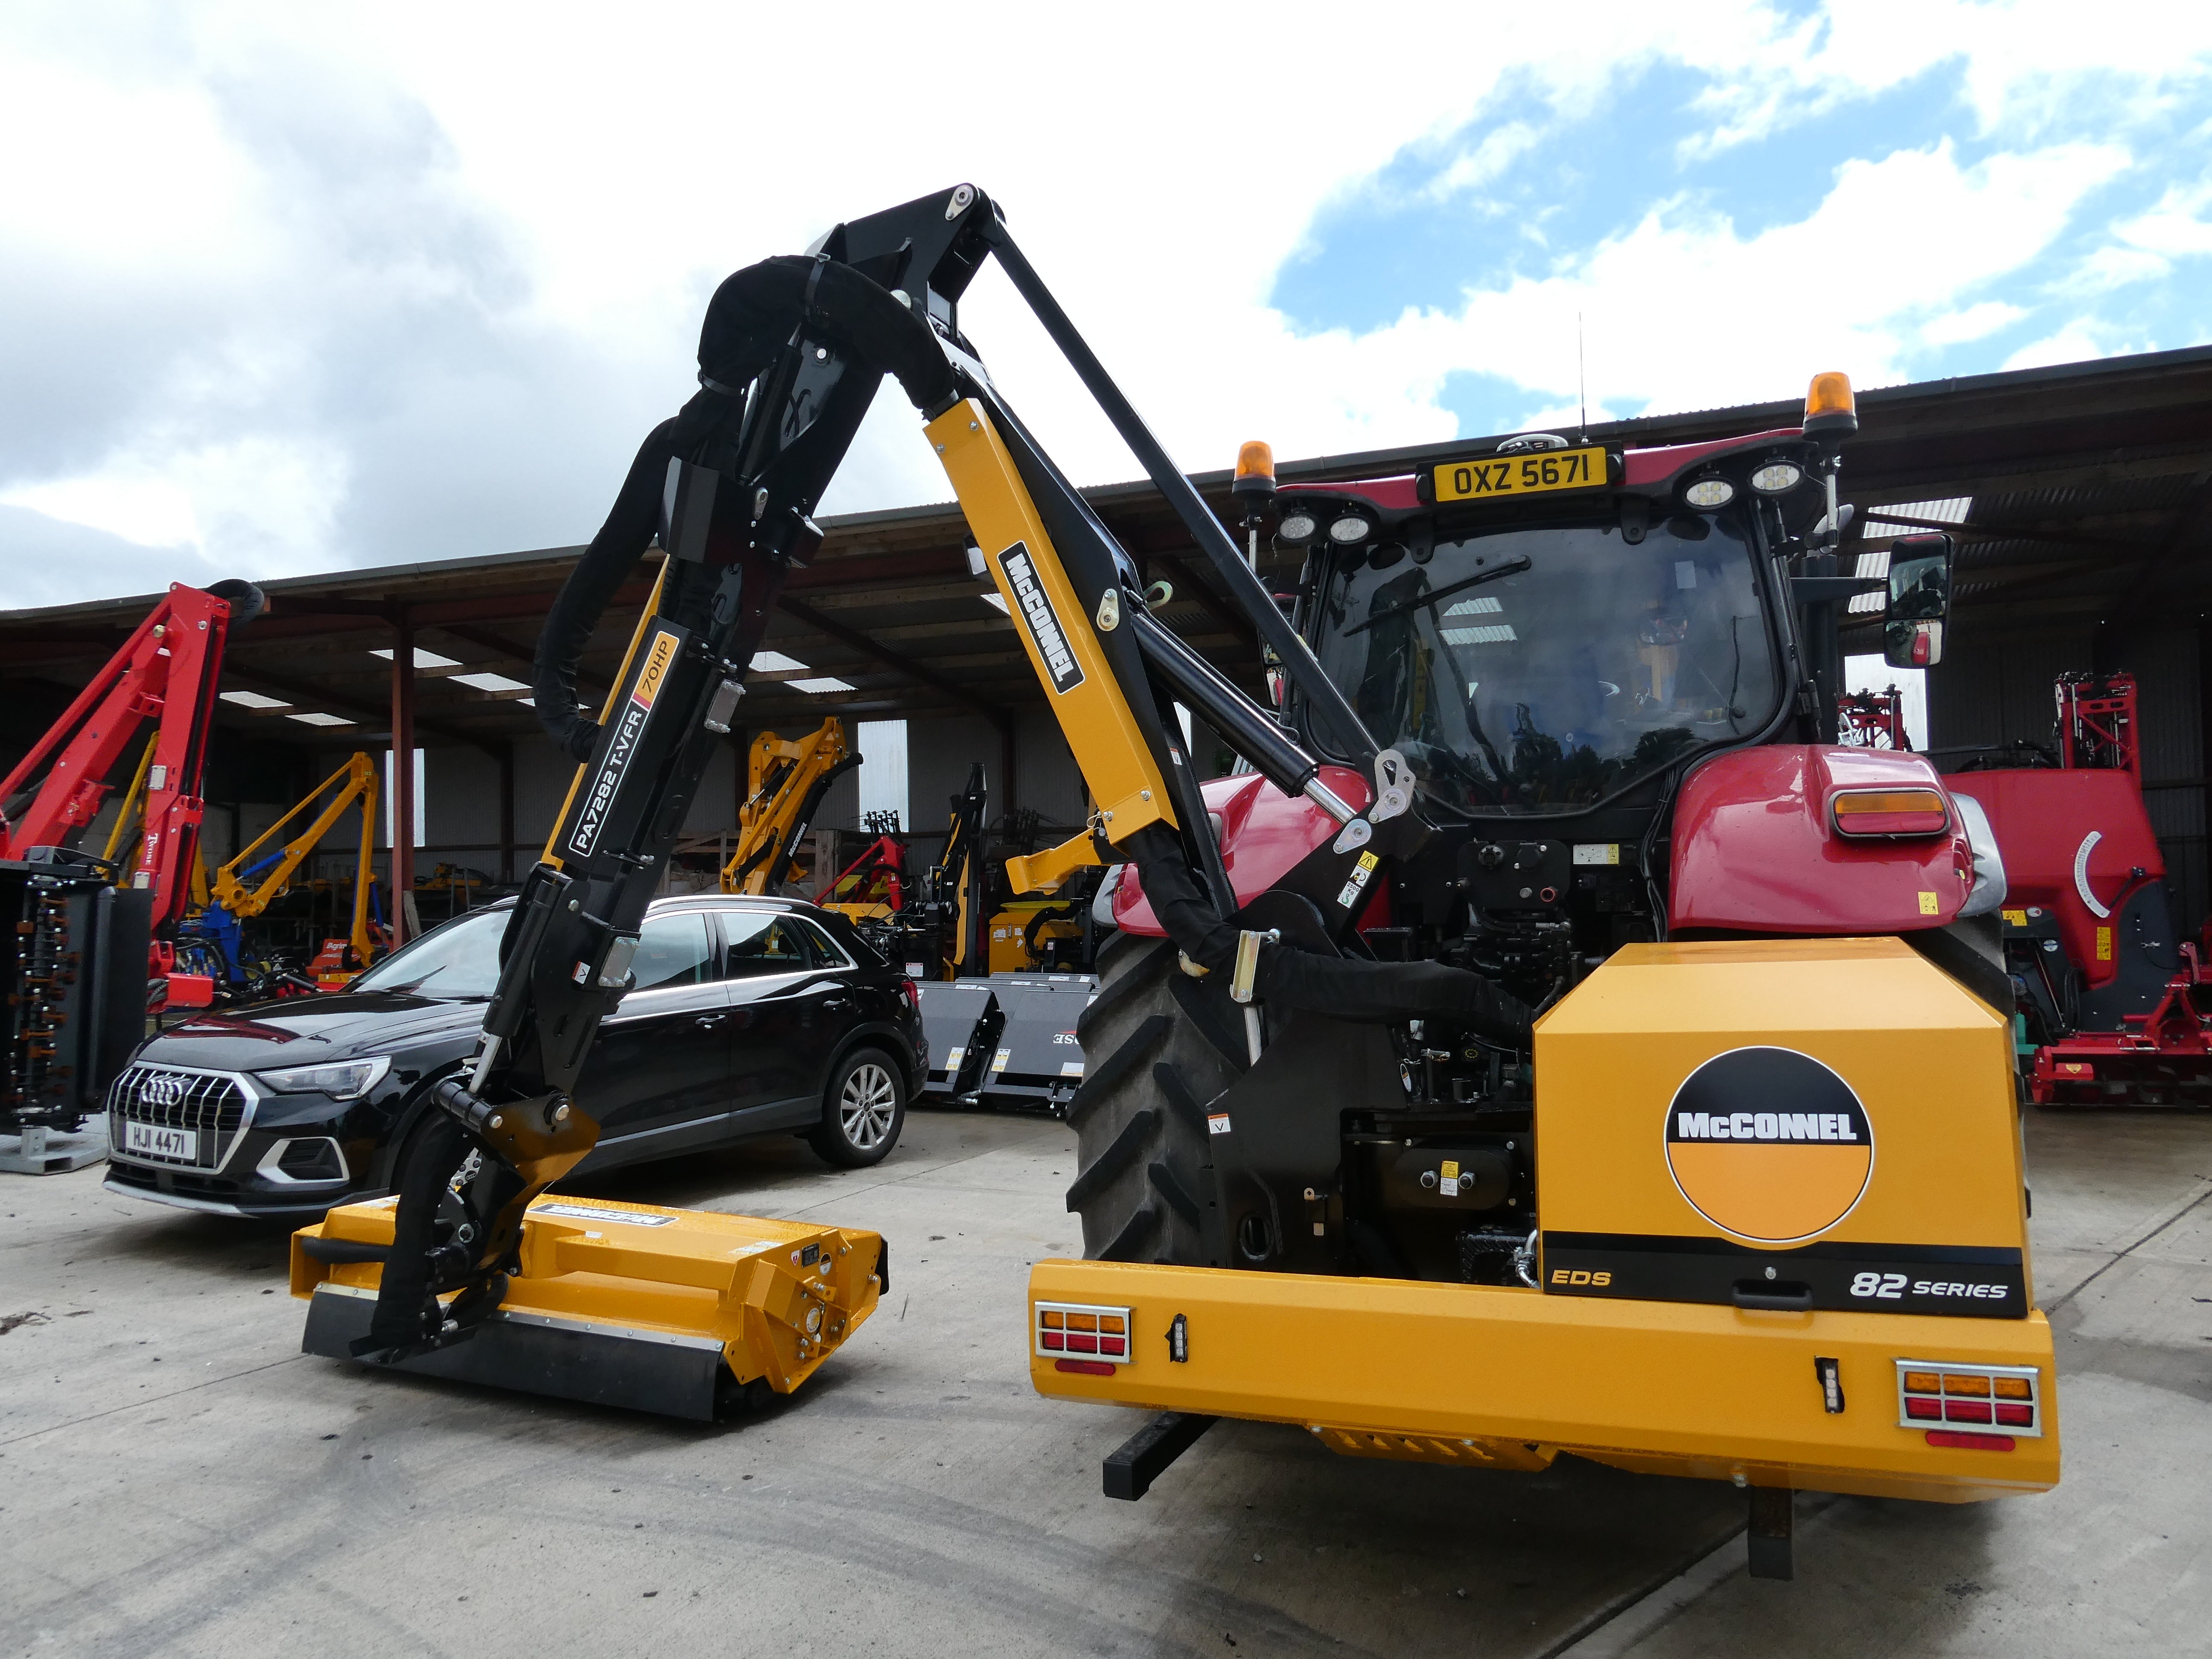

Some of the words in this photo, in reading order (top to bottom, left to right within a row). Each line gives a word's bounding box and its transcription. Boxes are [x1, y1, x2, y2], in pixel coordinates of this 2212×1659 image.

[1454, 463, 1512, 494] OXZ
[1522, 454, 1589, 487] 5671
[642, 640, 667, 693] 70HP
[576, 770, 617, 849] PA7282
[611, 711, 642, 765] T-VFR
[1347, 882, 1359, 892] 2500
[134, 1126, 151, 1149] HJI
[155, 1131, 184, 1154] 4471
[1551, 1269, 1611, 1286] EDS
[1850, 1272, 1907, 1298] 82
[1912, 1281, 2008, 1298] SERIES
